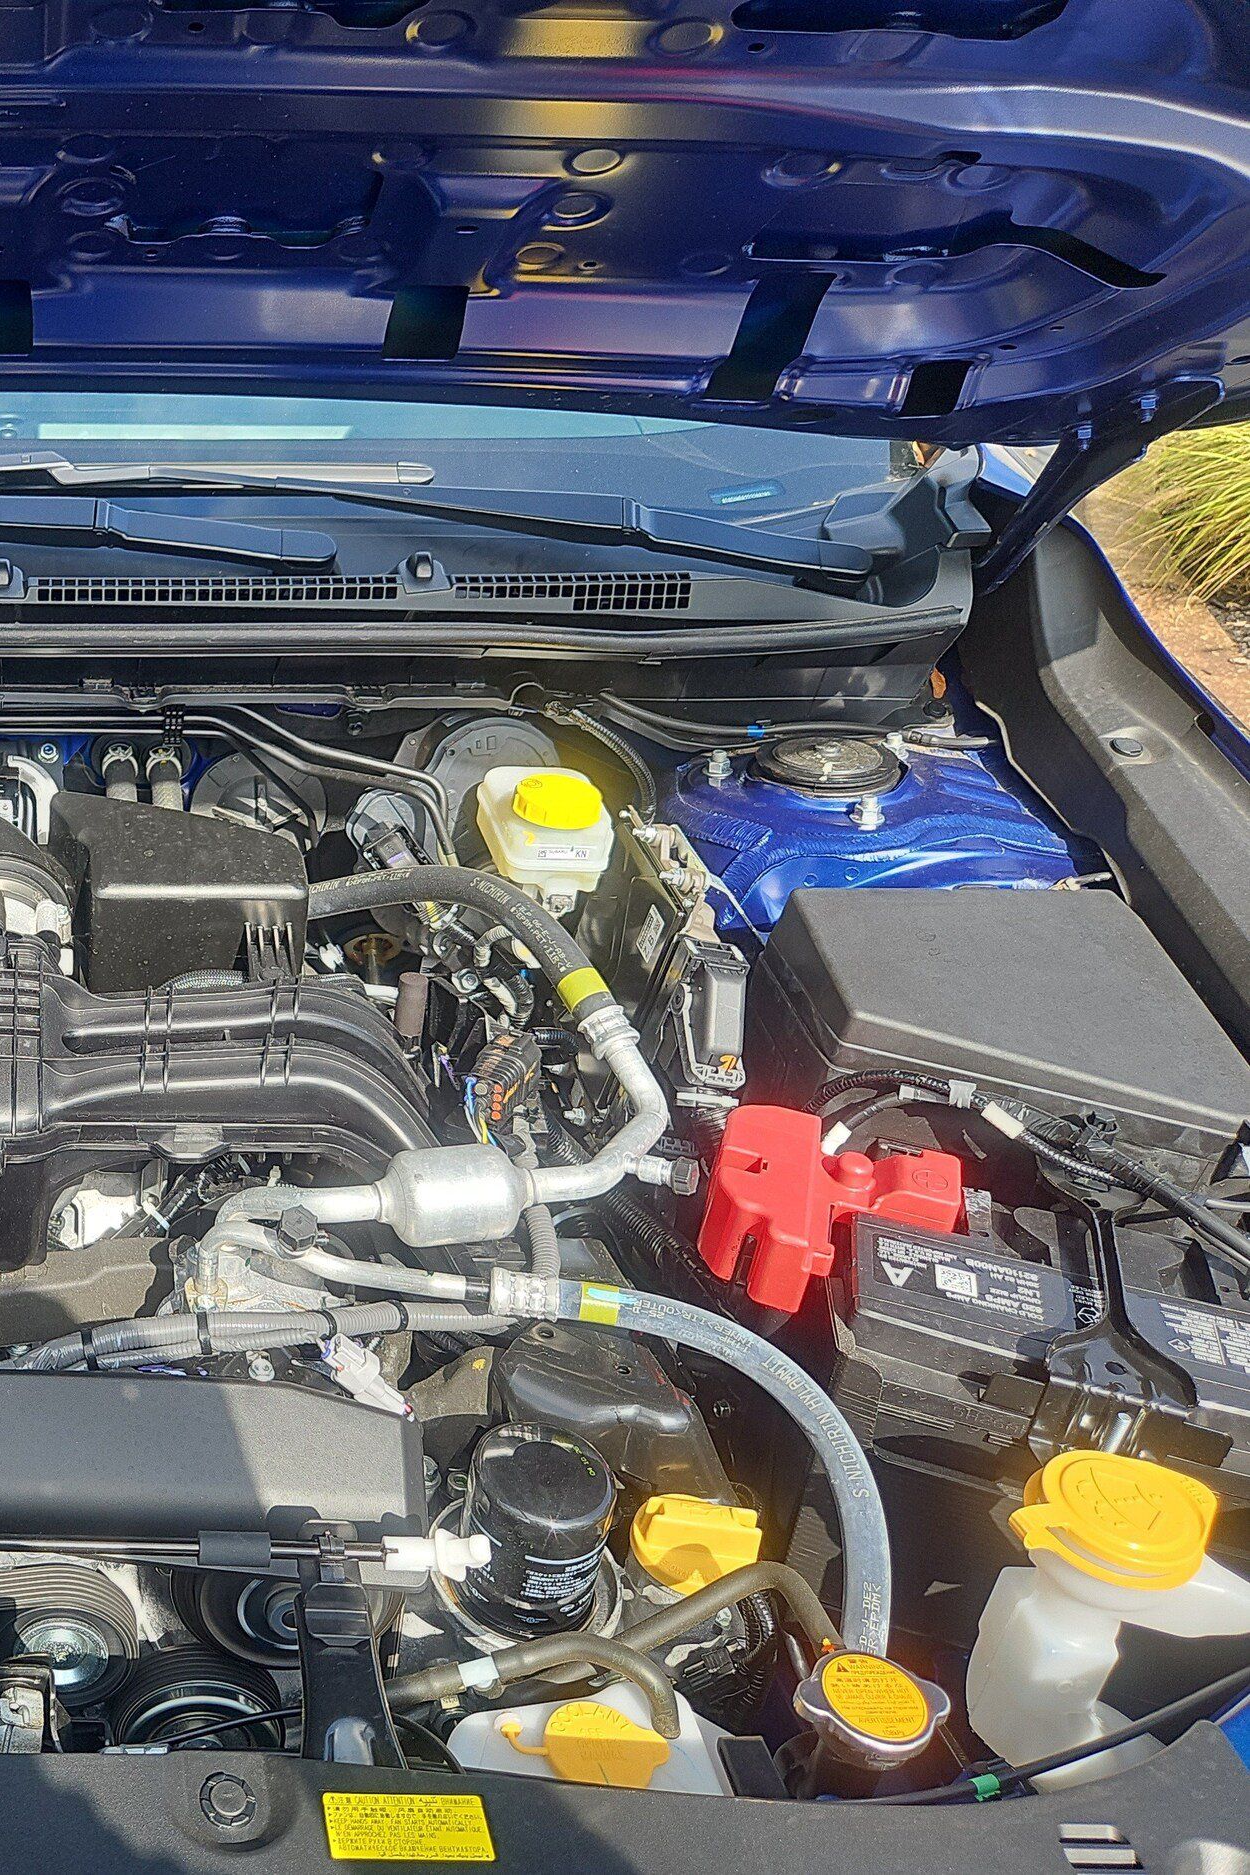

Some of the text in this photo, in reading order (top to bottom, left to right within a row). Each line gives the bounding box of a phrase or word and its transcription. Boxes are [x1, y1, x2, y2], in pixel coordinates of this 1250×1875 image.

[575, 849, 587, 858] KN
[945, 1291, 971, 1303] AMPS
[1016, 1286, 1041, 1298] LN2
[984, 1293, 1018, 1308] AMPS
[1018, 1308, 1044, 1321] COLD
[762, 1355, 825, 1413] HYLAMMIT
[551, 1703, 630, 1732] COOLANT
[354, 1797, 379, 1805] CAUTION
[383, 1797, 415, 1805] ATTENTION
